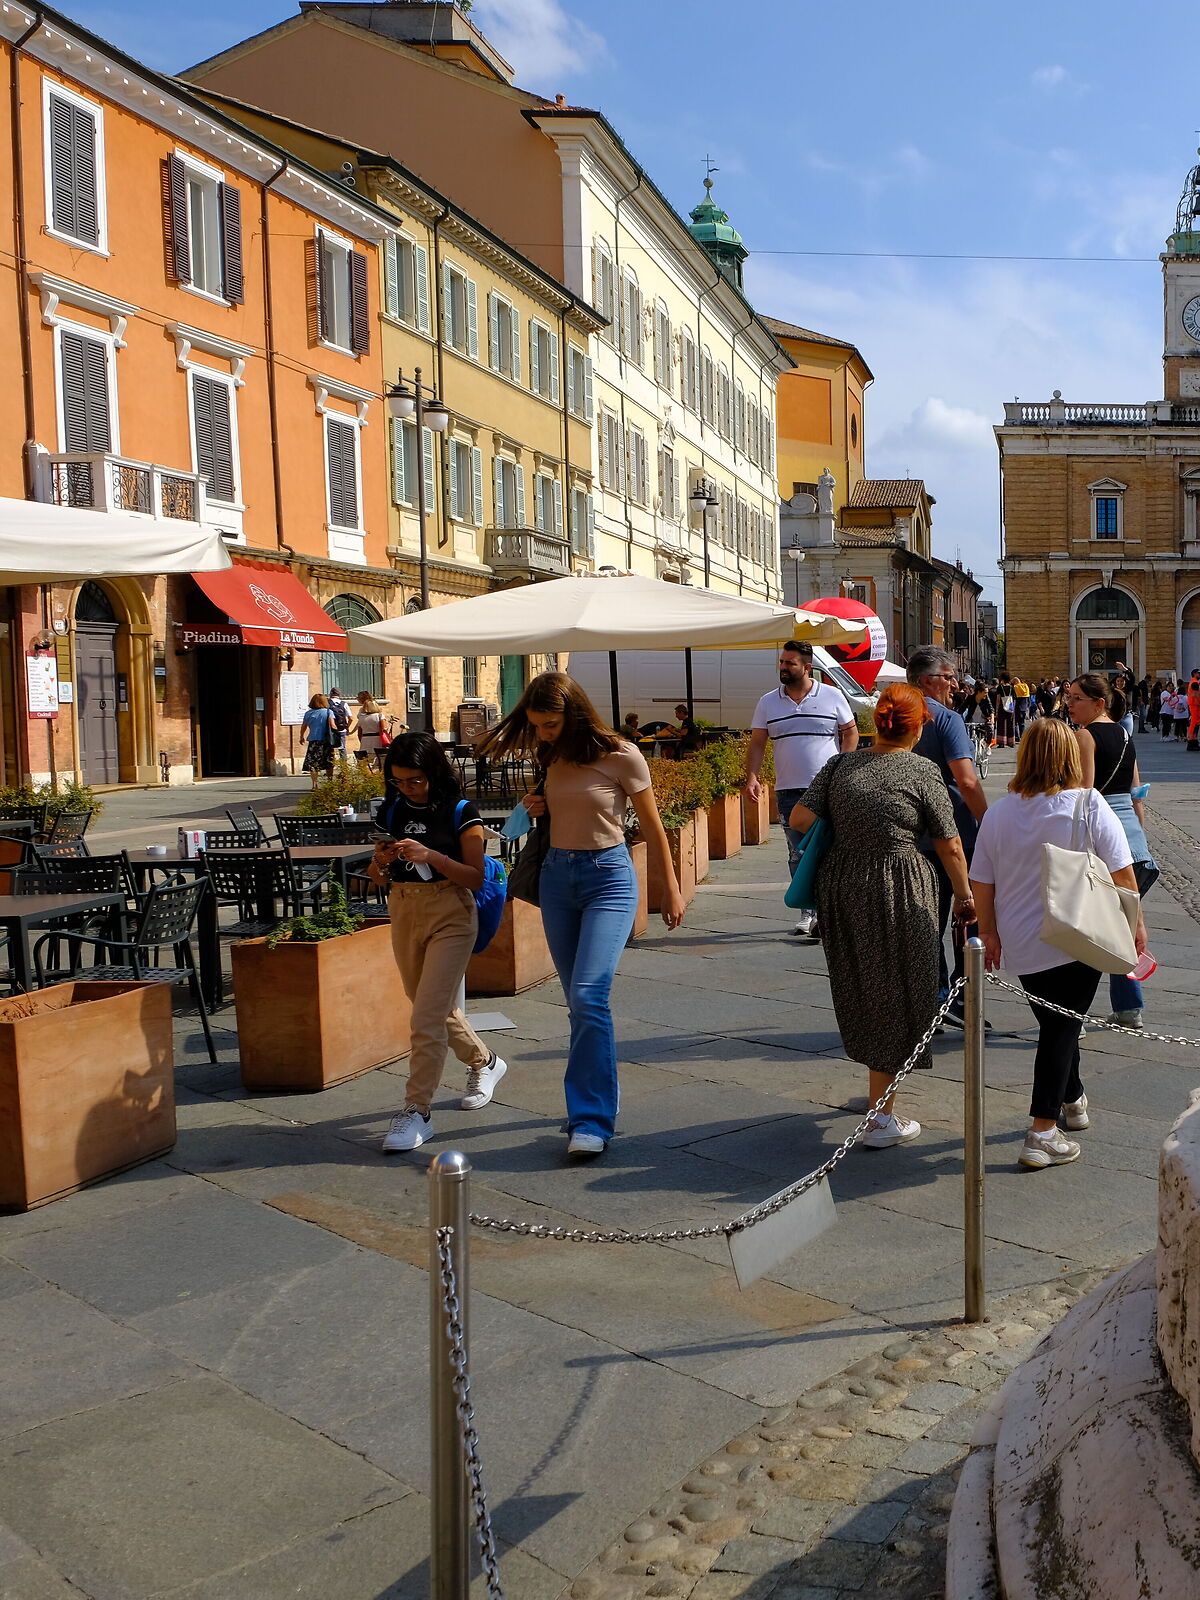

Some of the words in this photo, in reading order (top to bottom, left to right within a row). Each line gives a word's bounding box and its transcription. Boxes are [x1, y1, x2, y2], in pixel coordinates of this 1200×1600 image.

[183, 631, 240, 644] Piadina
[280, 631, 290, 642] La
[291, 632, 315, 644] Tonda
